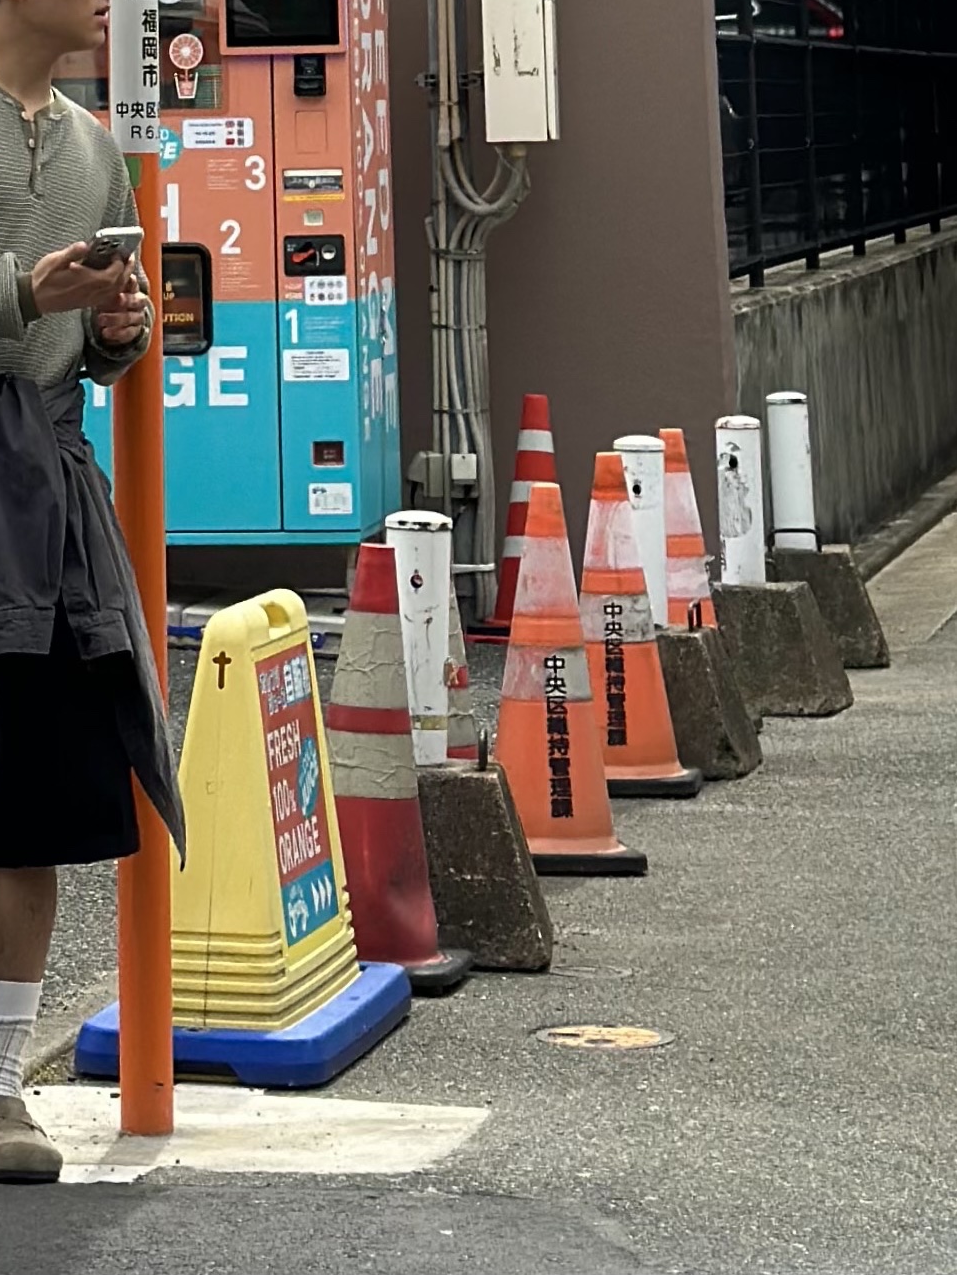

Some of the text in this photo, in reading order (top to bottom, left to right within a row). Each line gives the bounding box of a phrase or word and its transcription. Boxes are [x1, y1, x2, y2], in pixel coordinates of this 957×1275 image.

[141, 9, 158, 88] 福岡市
[116, 101, 160, 119] 中央区
[244, 155, 267, 191] 3
[219, 219, 241, 255] 2
[284, 308, 299, 344] 1
[359, 245, 372, 443] ORANGE
[267, 719, 301, 771] FRESH
[273, 778, 297, 822] 100%
[278, 816, 321, 874] ORANGE
